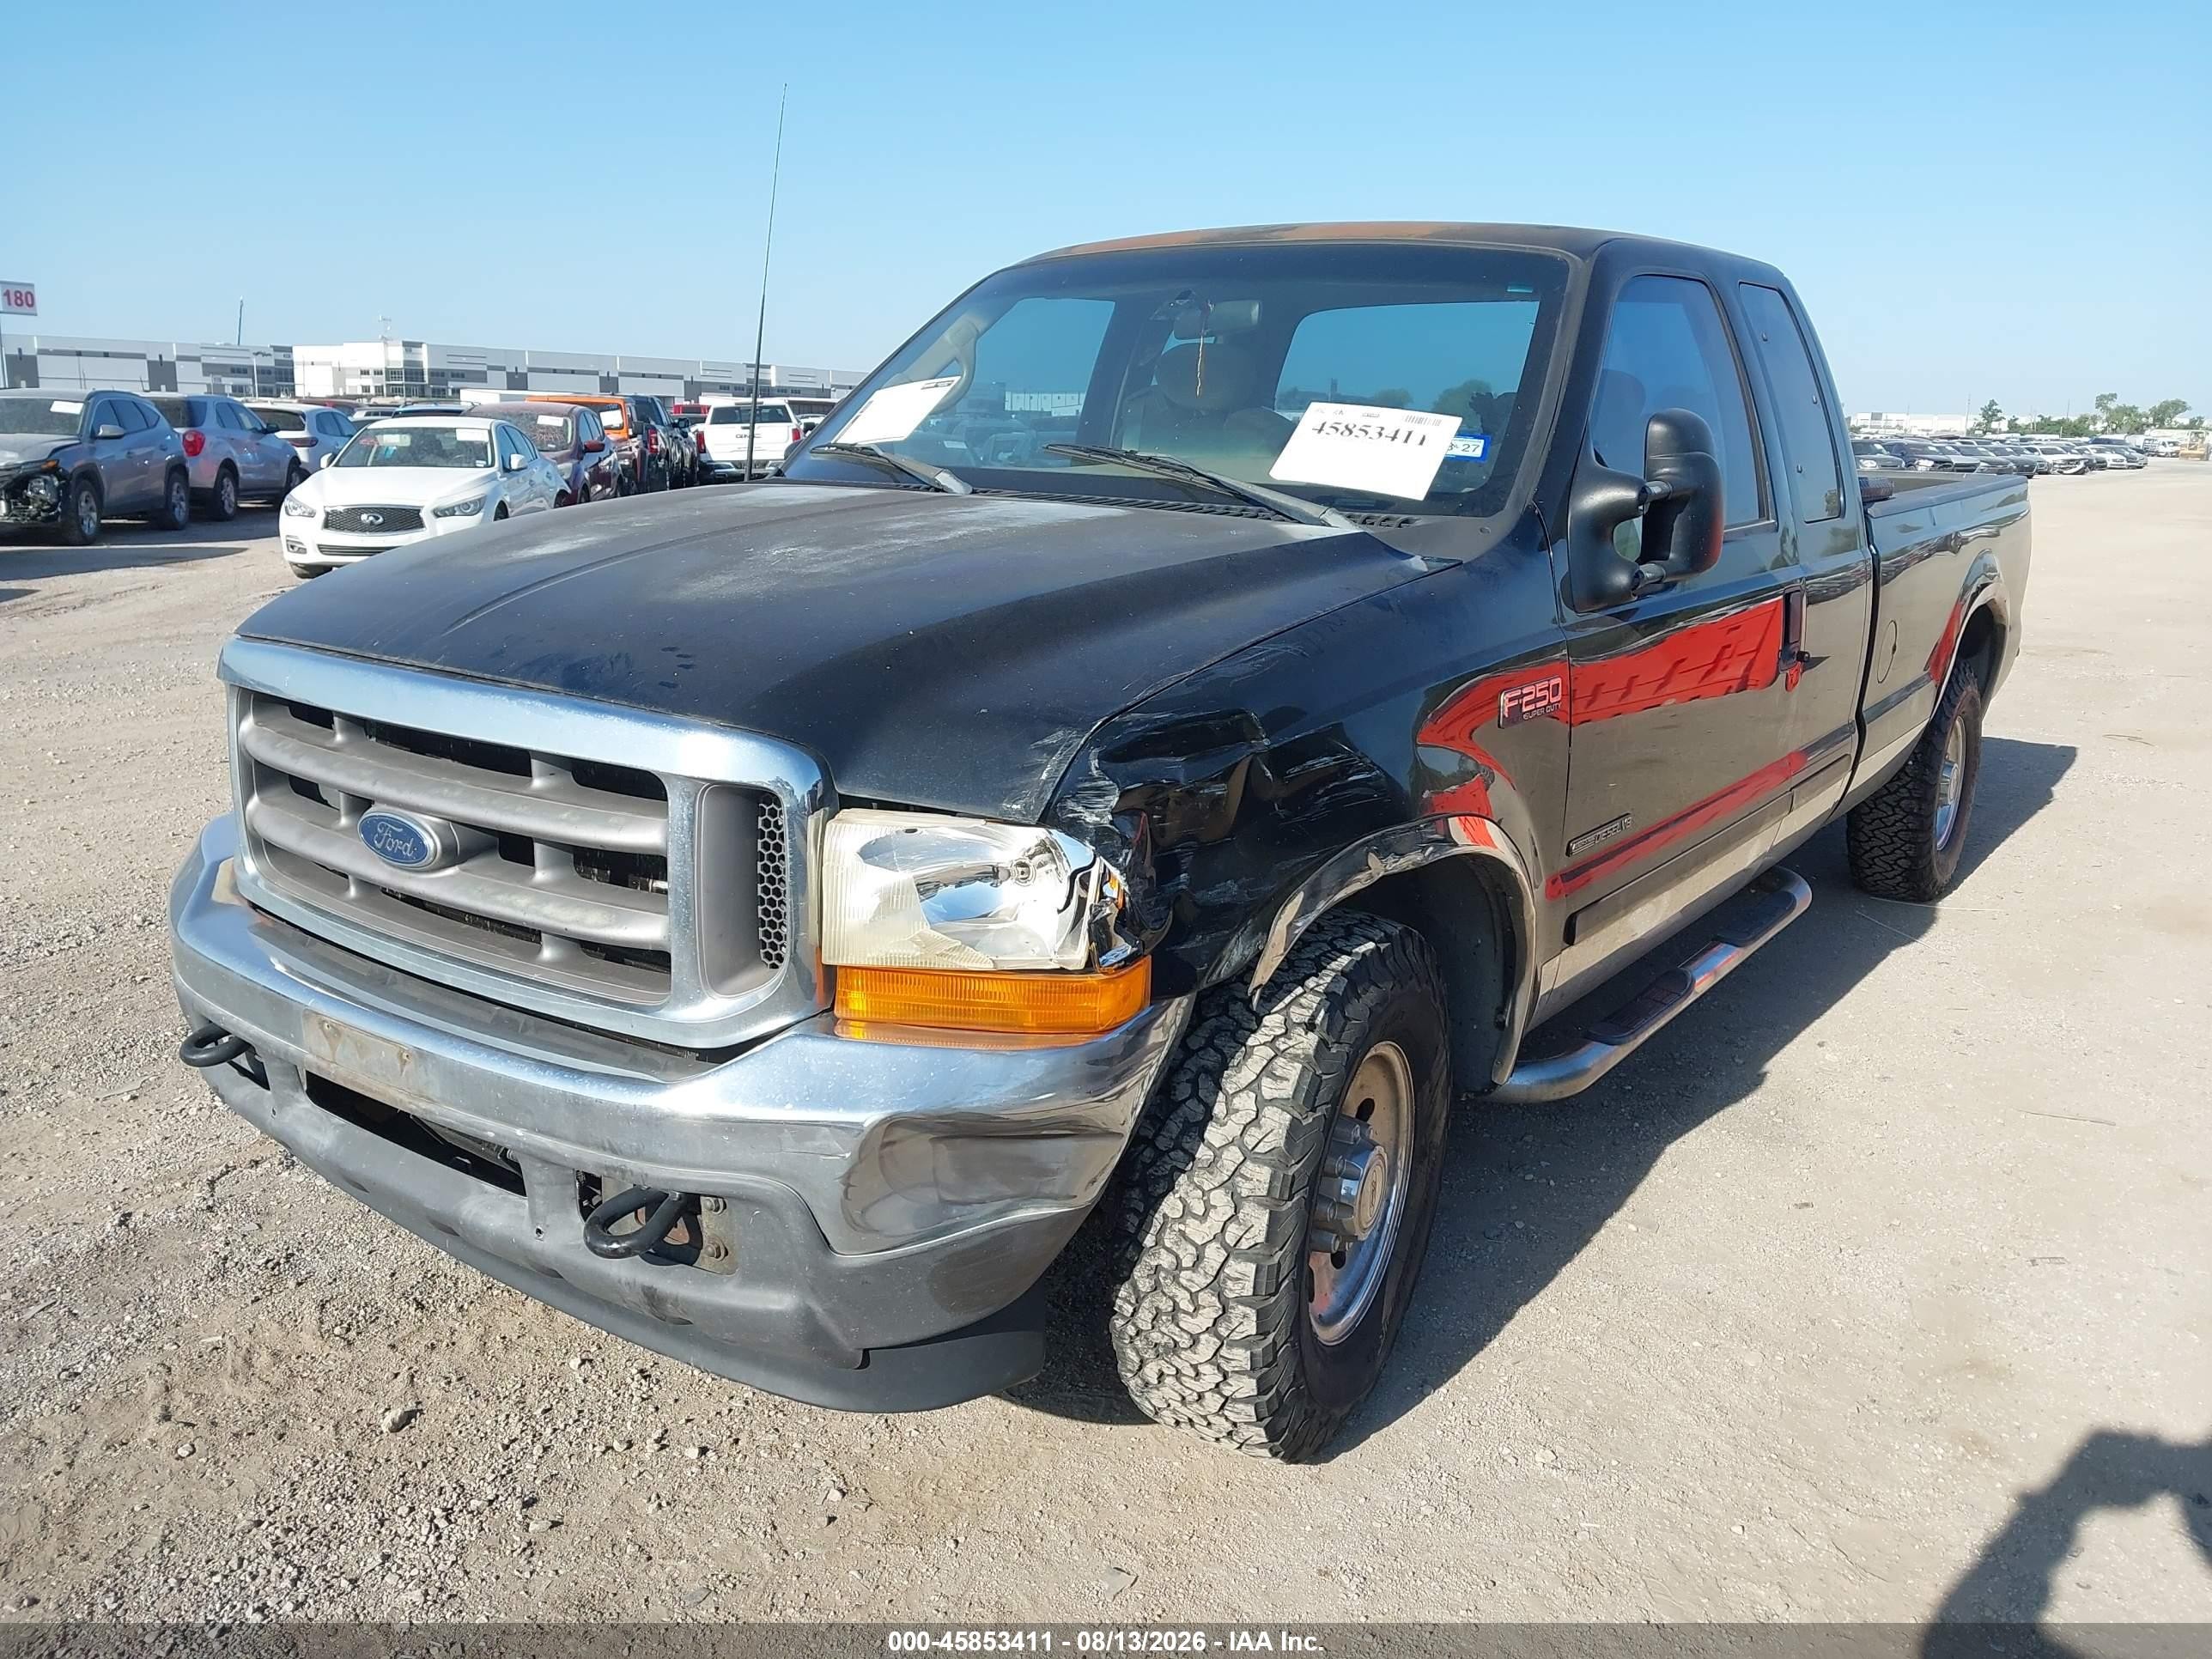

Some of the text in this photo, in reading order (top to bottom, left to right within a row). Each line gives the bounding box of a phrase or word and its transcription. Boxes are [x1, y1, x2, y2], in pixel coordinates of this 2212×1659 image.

[3, 289, 35, 307] 180
[1311, 420, 1427, 447] 45853411
[1461, 443, 1480, 453] 27
[1522, 702, 1562, 720] SUPER DUTY
[374, 821, 415, 857] Ford
